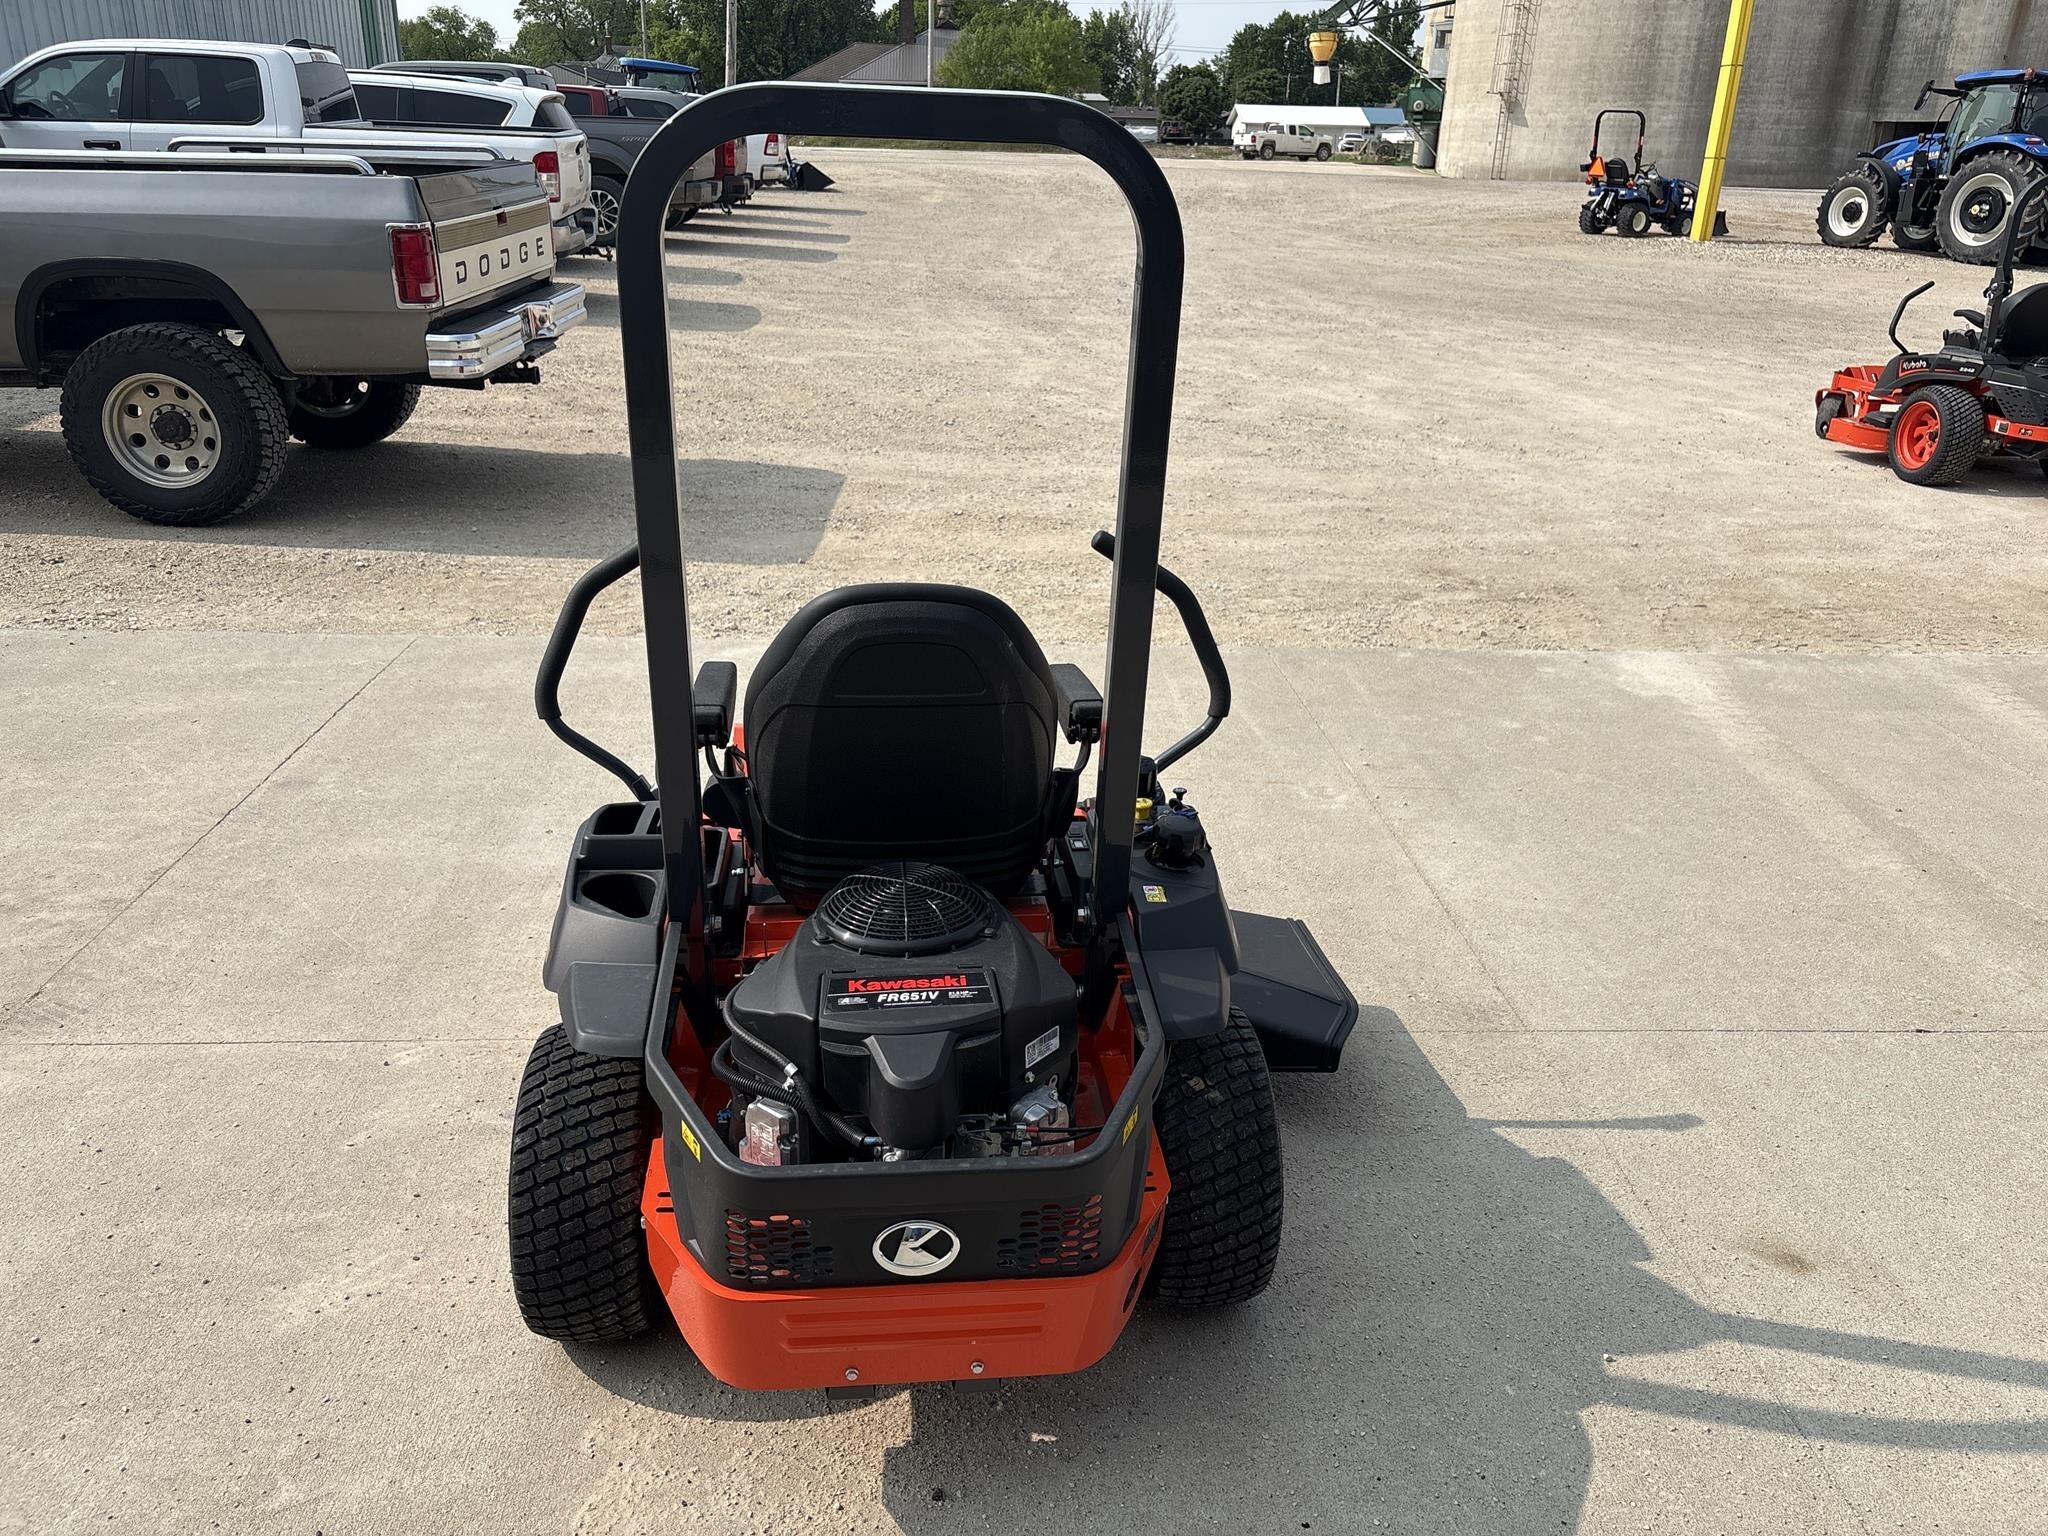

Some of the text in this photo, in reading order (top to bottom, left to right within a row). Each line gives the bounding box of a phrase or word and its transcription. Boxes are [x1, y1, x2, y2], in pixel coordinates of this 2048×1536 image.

[455, 237, 545, 285] DODGE
[1902, 359, 1927, 370] Kubota
[848, 975, 968, 992] Kawasaki
[877, 991, 940, 1003] FR651V
